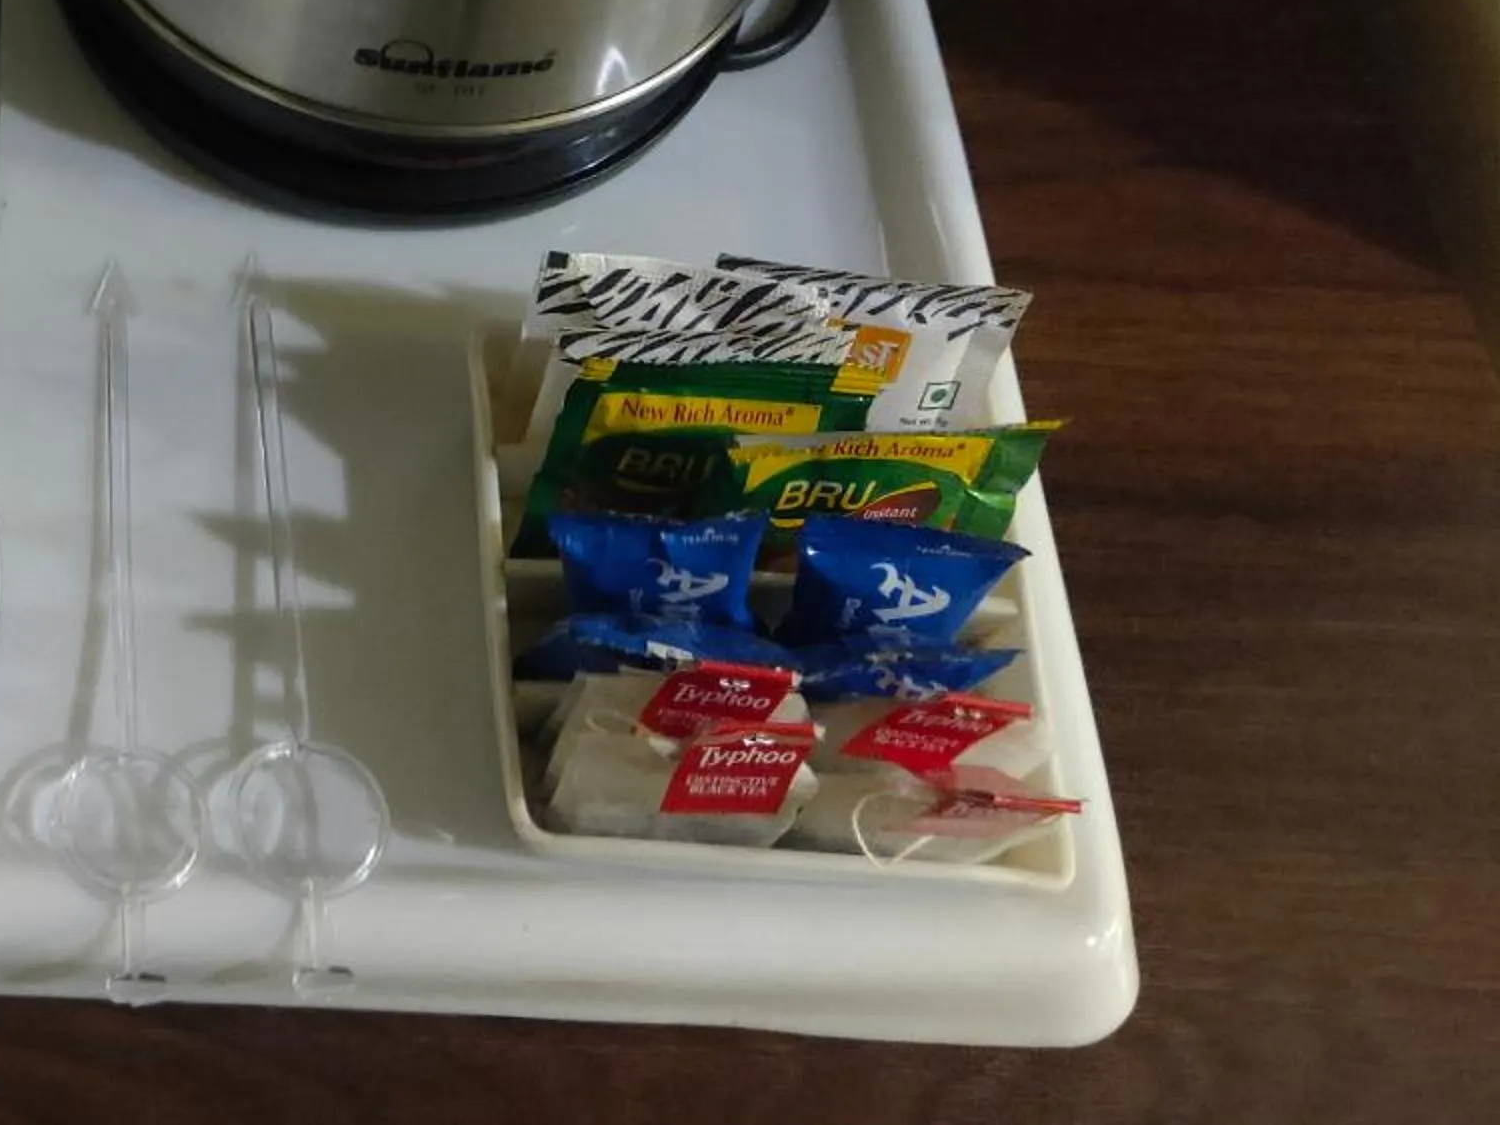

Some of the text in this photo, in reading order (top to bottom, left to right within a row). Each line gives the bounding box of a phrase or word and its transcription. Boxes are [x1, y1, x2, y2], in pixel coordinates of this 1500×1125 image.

[353, 47, 556, 78] Sunflame
[621, 398, 666, 420] New
[673, 404, 714, 424] Rich
[833, 438, 879, 457] Rich
[617, 446, 717, 484] BRU
[775, 479, 877, 511] BRU
[672, 682, 771, 710] Typhoo
[699, 746, 797, 767] Typhoo
